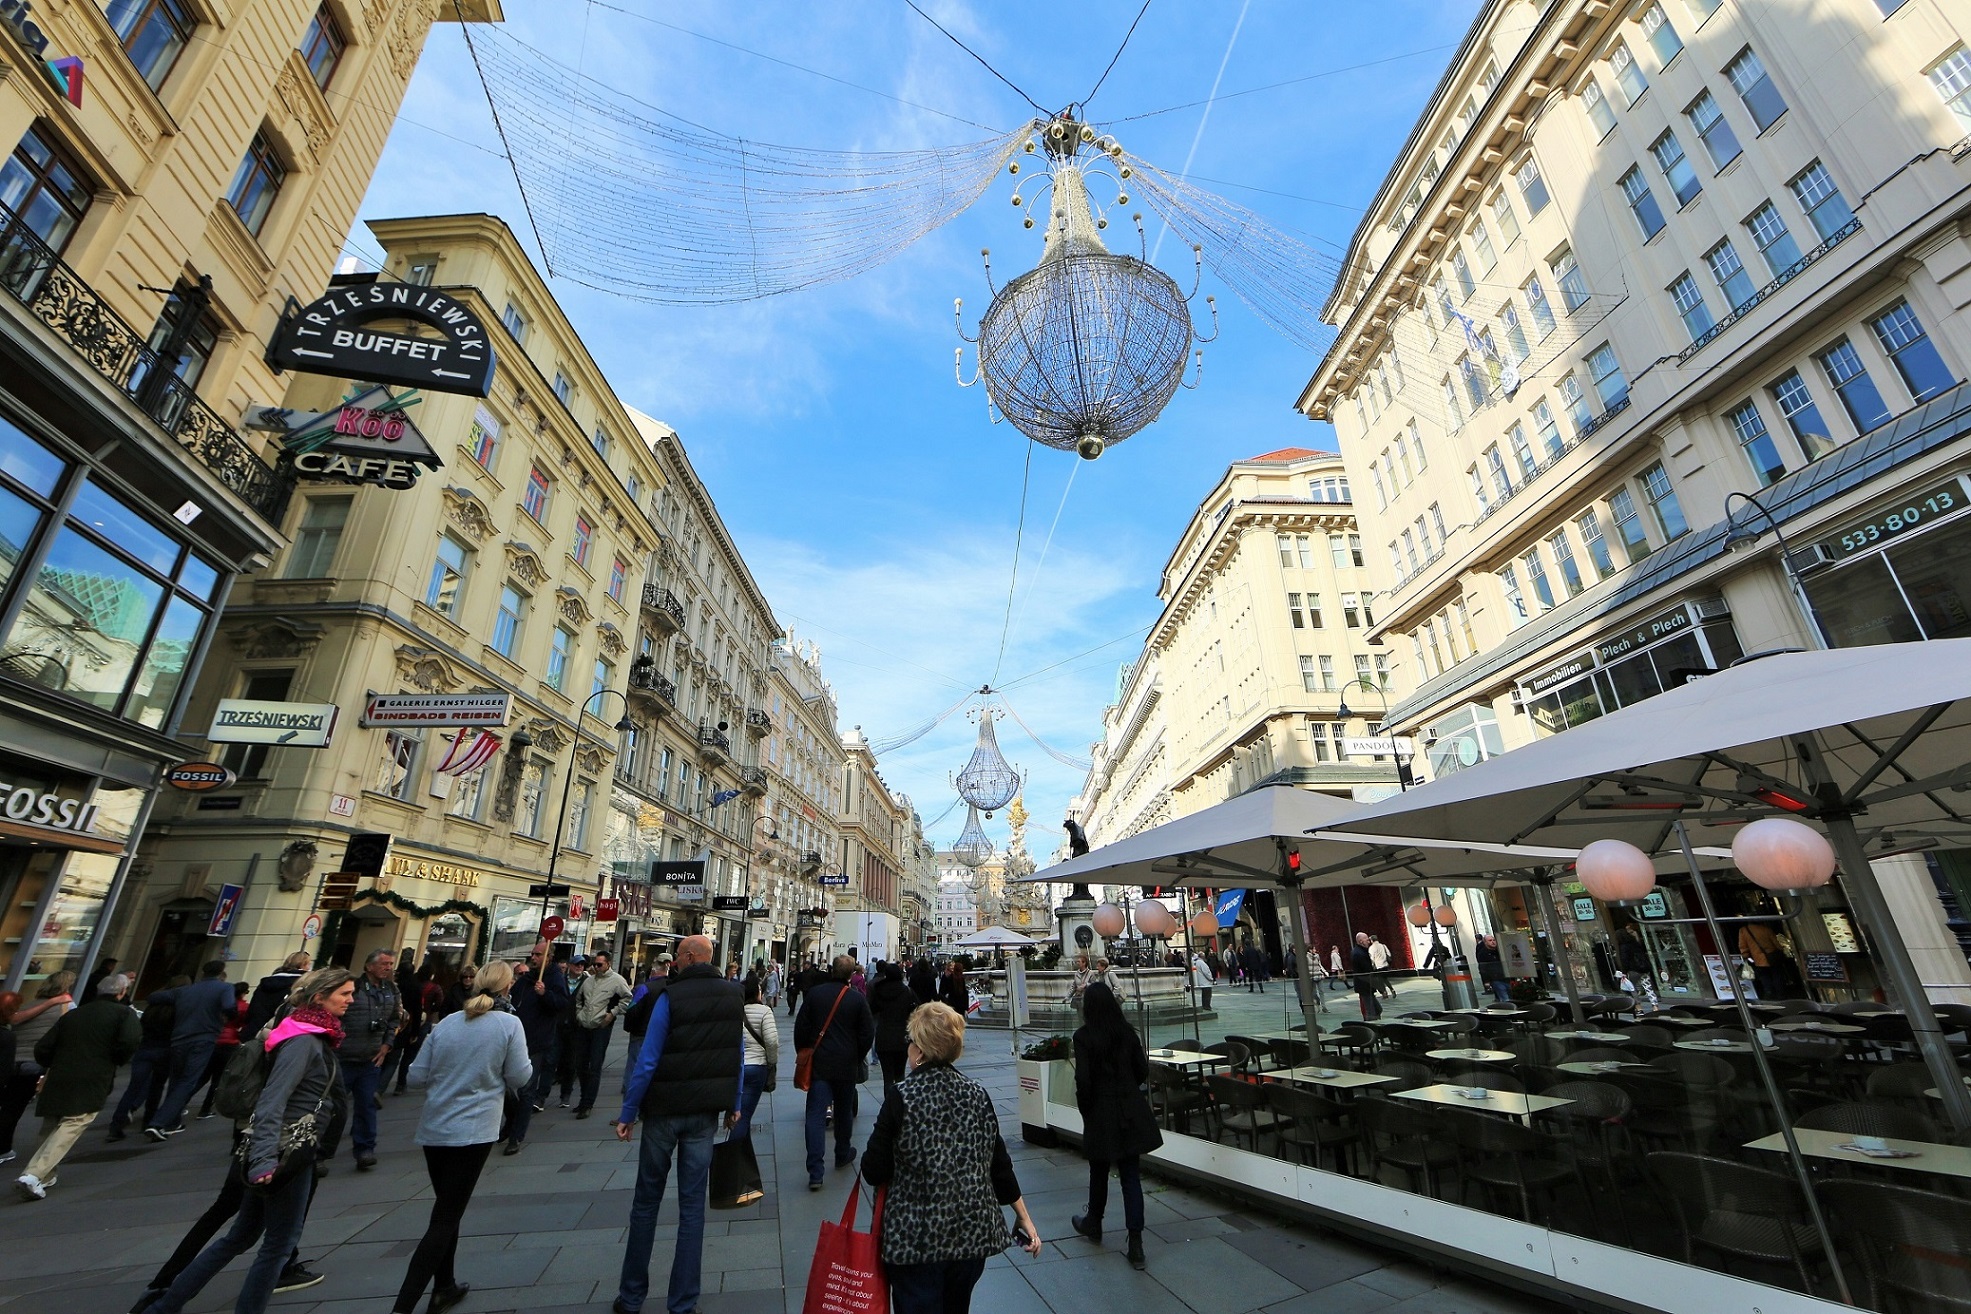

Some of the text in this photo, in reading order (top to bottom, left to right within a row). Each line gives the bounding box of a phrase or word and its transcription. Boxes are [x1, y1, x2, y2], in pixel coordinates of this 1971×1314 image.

[332, 329, 447, 361] BUFFET
[294, 453, 412, 482] CAFE
[1601, 613, 1686, 660] Plech & Plech
[1533, 661, 1582, 692] Immobilien
[219, 709, 324, 729] TRZEŚNIEWSKI
[171, 770, 223, 782] FOSSIL
[0, 781, 100, 834] OSSIL
[860, 1271, 874, 1279] your
[852, 1299, 870, 1310] about
[855, 1289, 874, 1300] about
